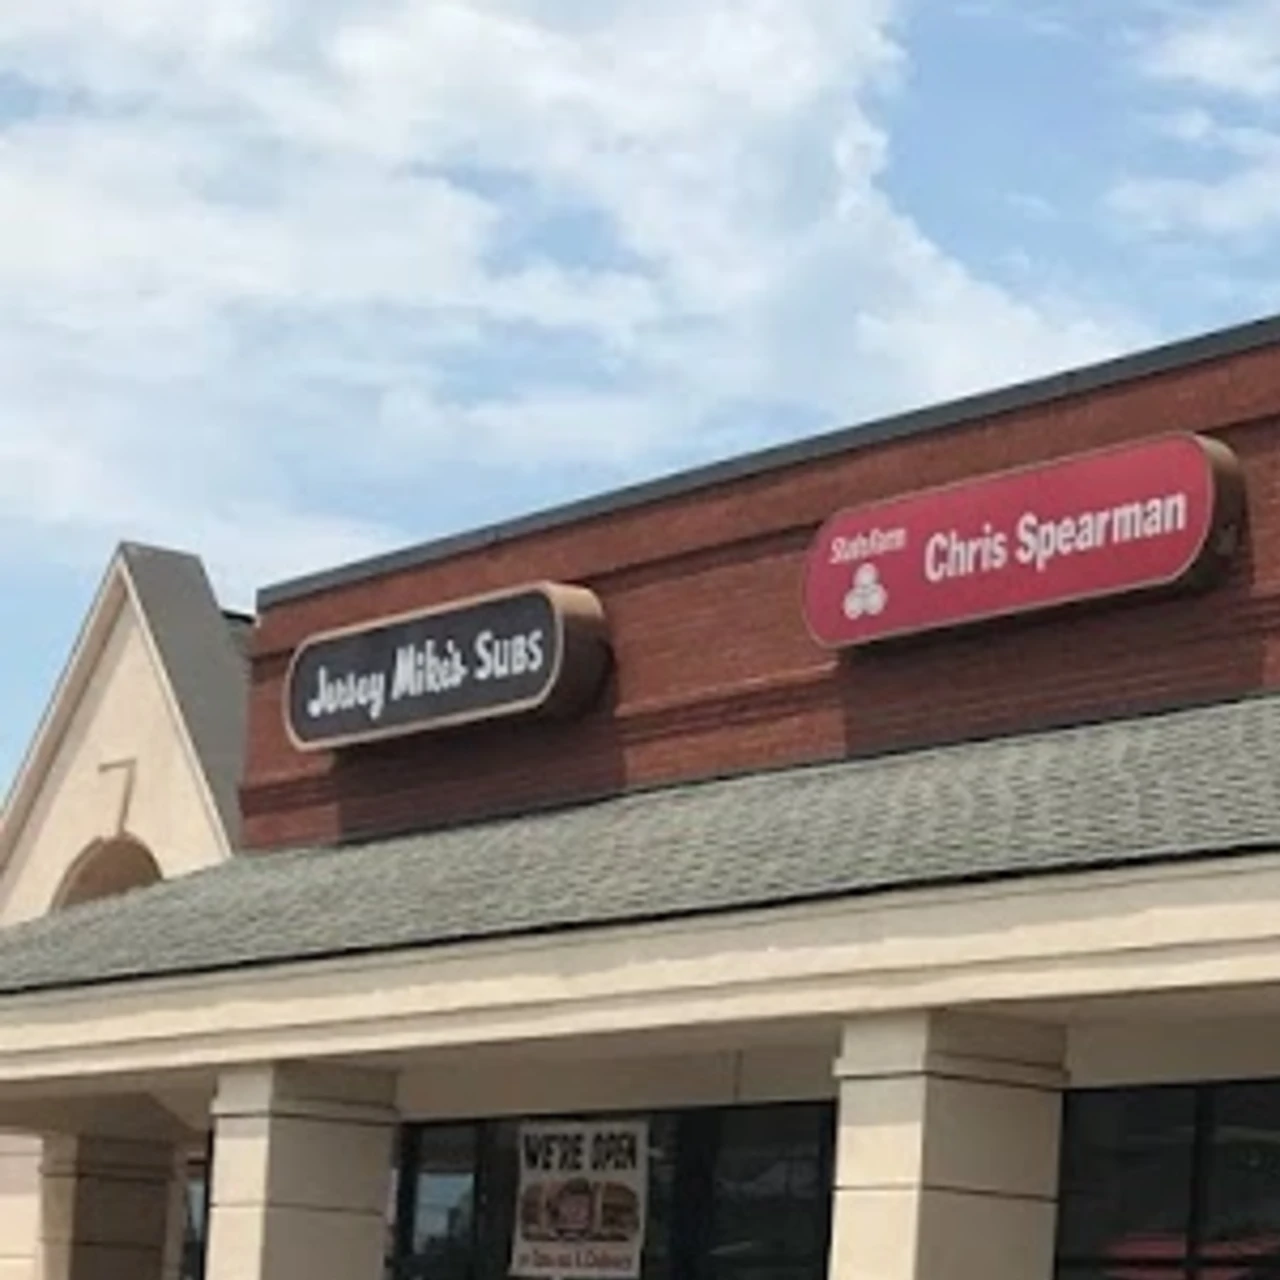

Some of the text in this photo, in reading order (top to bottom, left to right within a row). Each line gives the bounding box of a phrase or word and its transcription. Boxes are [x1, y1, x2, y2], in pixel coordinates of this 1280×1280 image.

[924, 493, 1188, 583] Chris Spearman
[590, 1130, 640, 1172] OPEN
